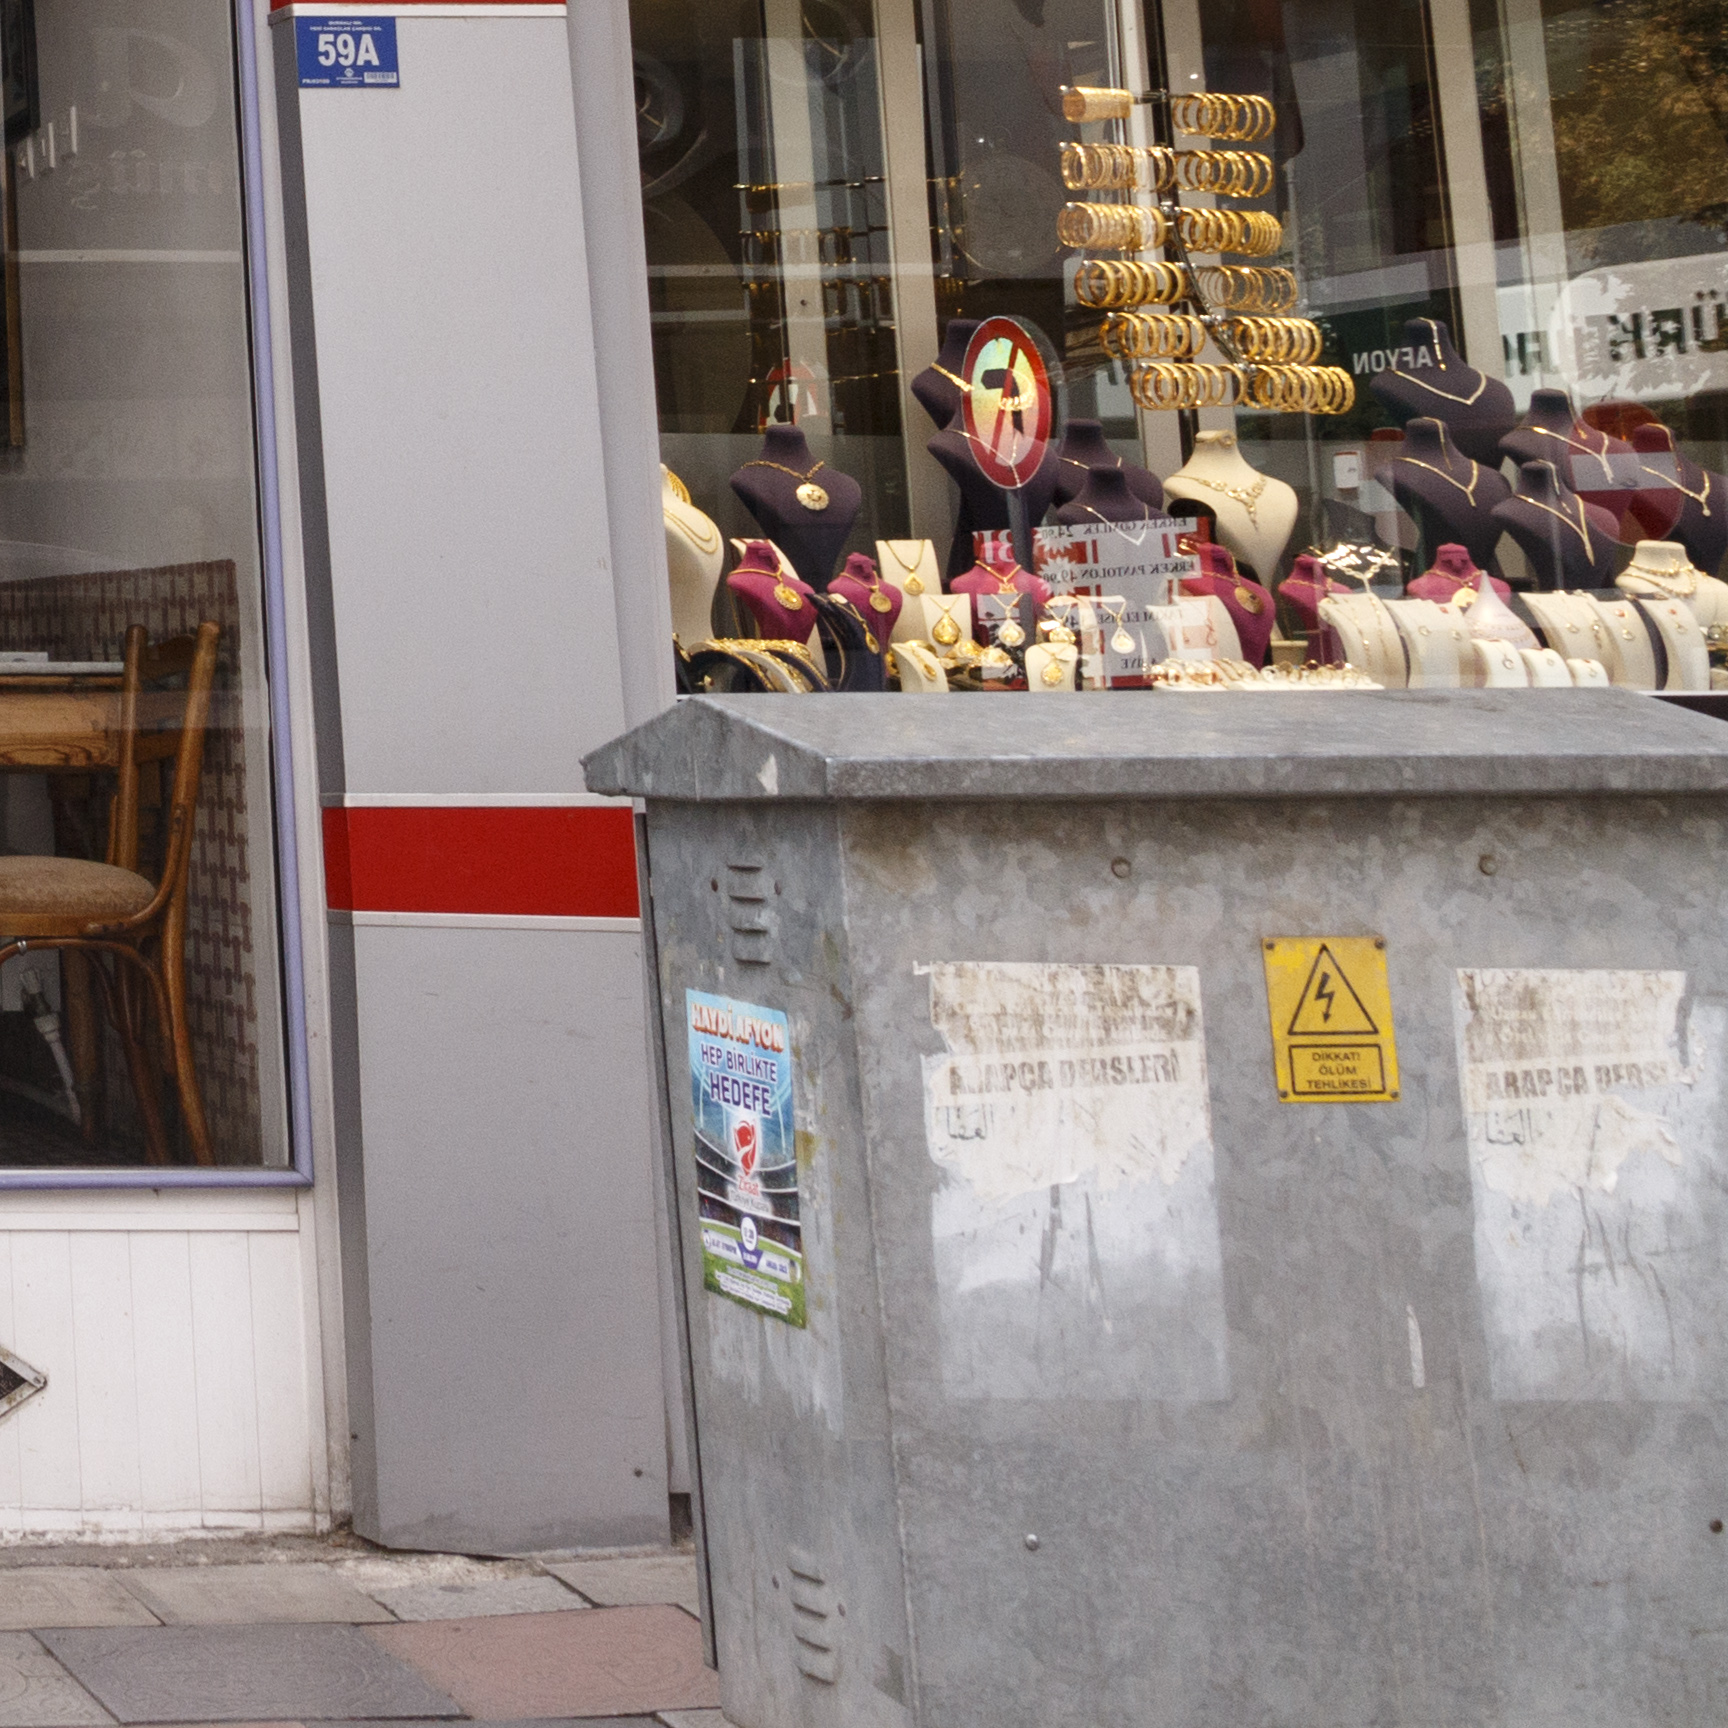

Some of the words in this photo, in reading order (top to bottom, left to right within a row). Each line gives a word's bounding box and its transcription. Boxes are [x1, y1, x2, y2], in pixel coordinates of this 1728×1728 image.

[318, 33, 380, 67] 59A
[735, 1014, 784, 1053] AFYON
[701, 1043, 723, 1066] HEP
[726, 1046, 777, 1082] BİRLİKTE
[1318, 1064, 1357, 1075] ÖLÜM
[710, 1071, 772, 1117] HEDEFE
